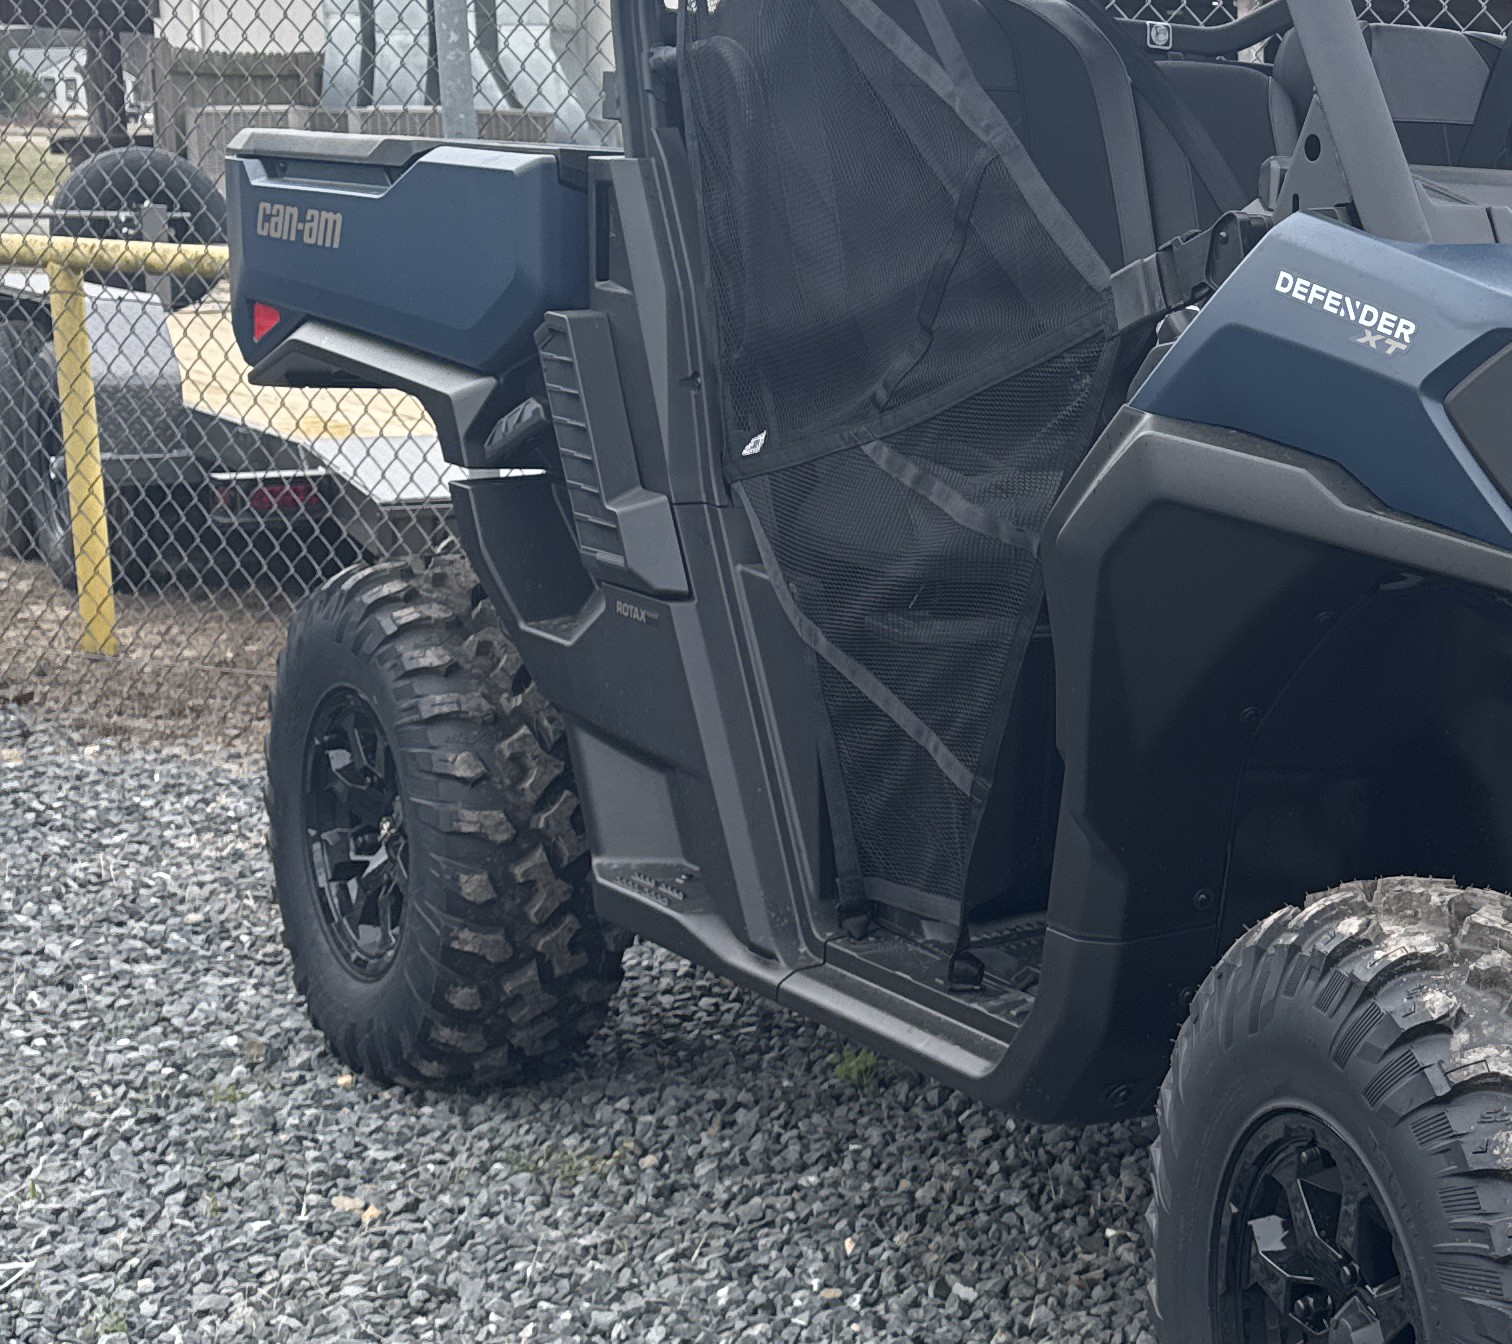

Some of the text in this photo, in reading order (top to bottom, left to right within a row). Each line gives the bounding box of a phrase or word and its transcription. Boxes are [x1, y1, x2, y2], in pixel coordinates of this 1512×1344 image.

[256, 201, 343, 249] can-am
[1274, 270, 1417, 344] DEFENDER
[1355, 328, 1408, 355] XT
[616, 599, 647, 623] ROTAX
